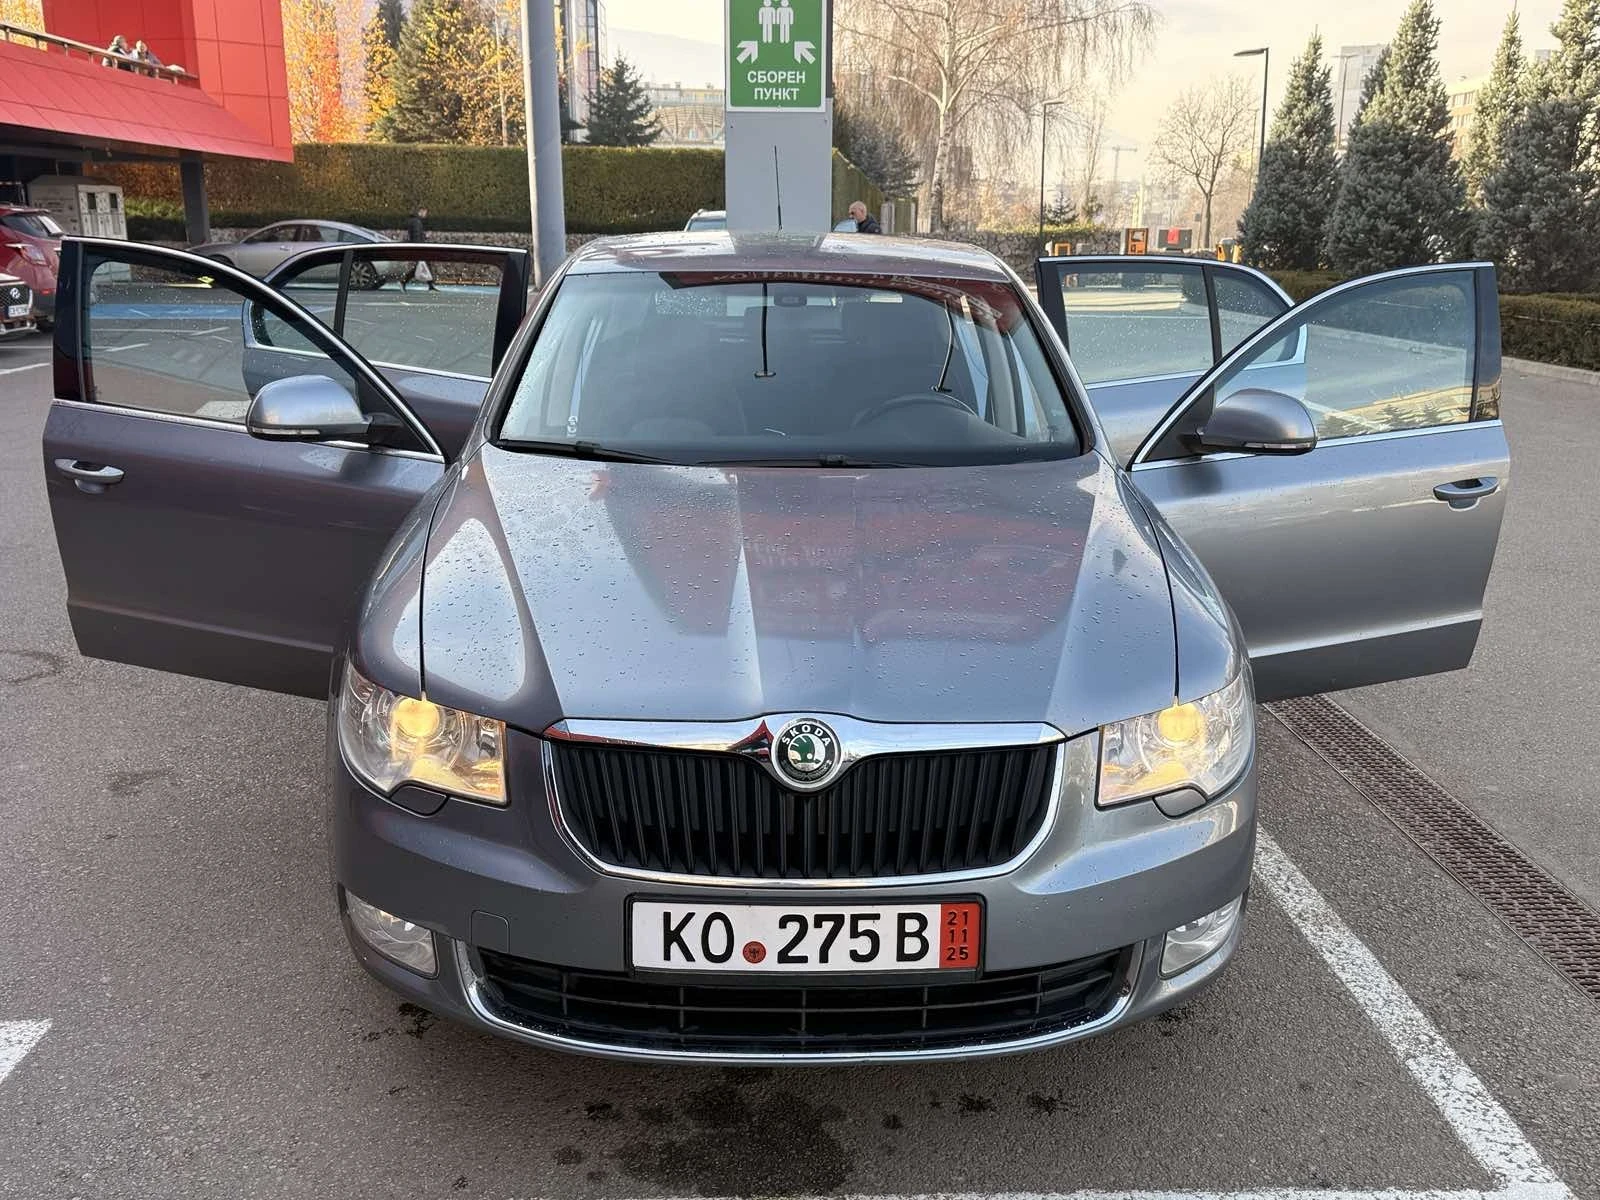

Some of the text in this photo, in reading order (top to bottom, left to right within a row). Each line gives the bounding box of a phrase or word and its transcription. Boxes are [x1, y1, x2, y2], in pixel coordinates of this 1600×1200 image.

[747, 71, 806, 83] СБОРЕН
[754, 87, 800, 101] ПУНКТ
[947, 910, 969, 925] 21
[663, 911, 930, 964] KO 275 B
[948, 927, 968, 943] 11
[947, 945, 969, 961] 25
